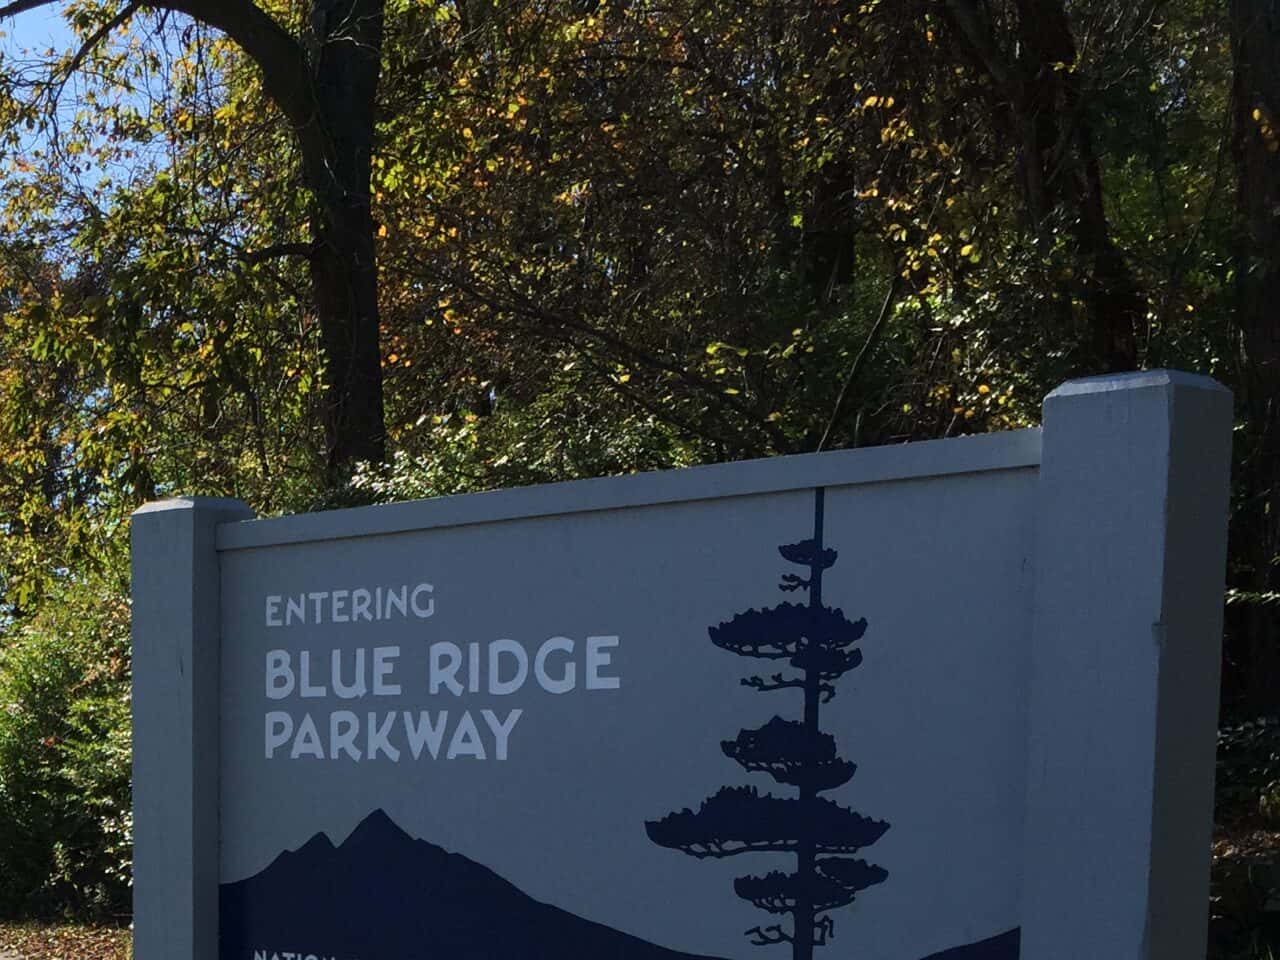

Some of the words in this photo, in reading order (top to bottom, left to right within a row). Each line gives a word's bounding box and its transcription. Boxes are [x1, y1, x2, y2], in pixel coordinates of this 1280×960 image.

[265, 583, 435, 627] ENTERING
[265, 645, 402, 700] BLUE
[429, 635, 621, 697] RIDGE
[265, 709, 524, 762] PARKWAY
